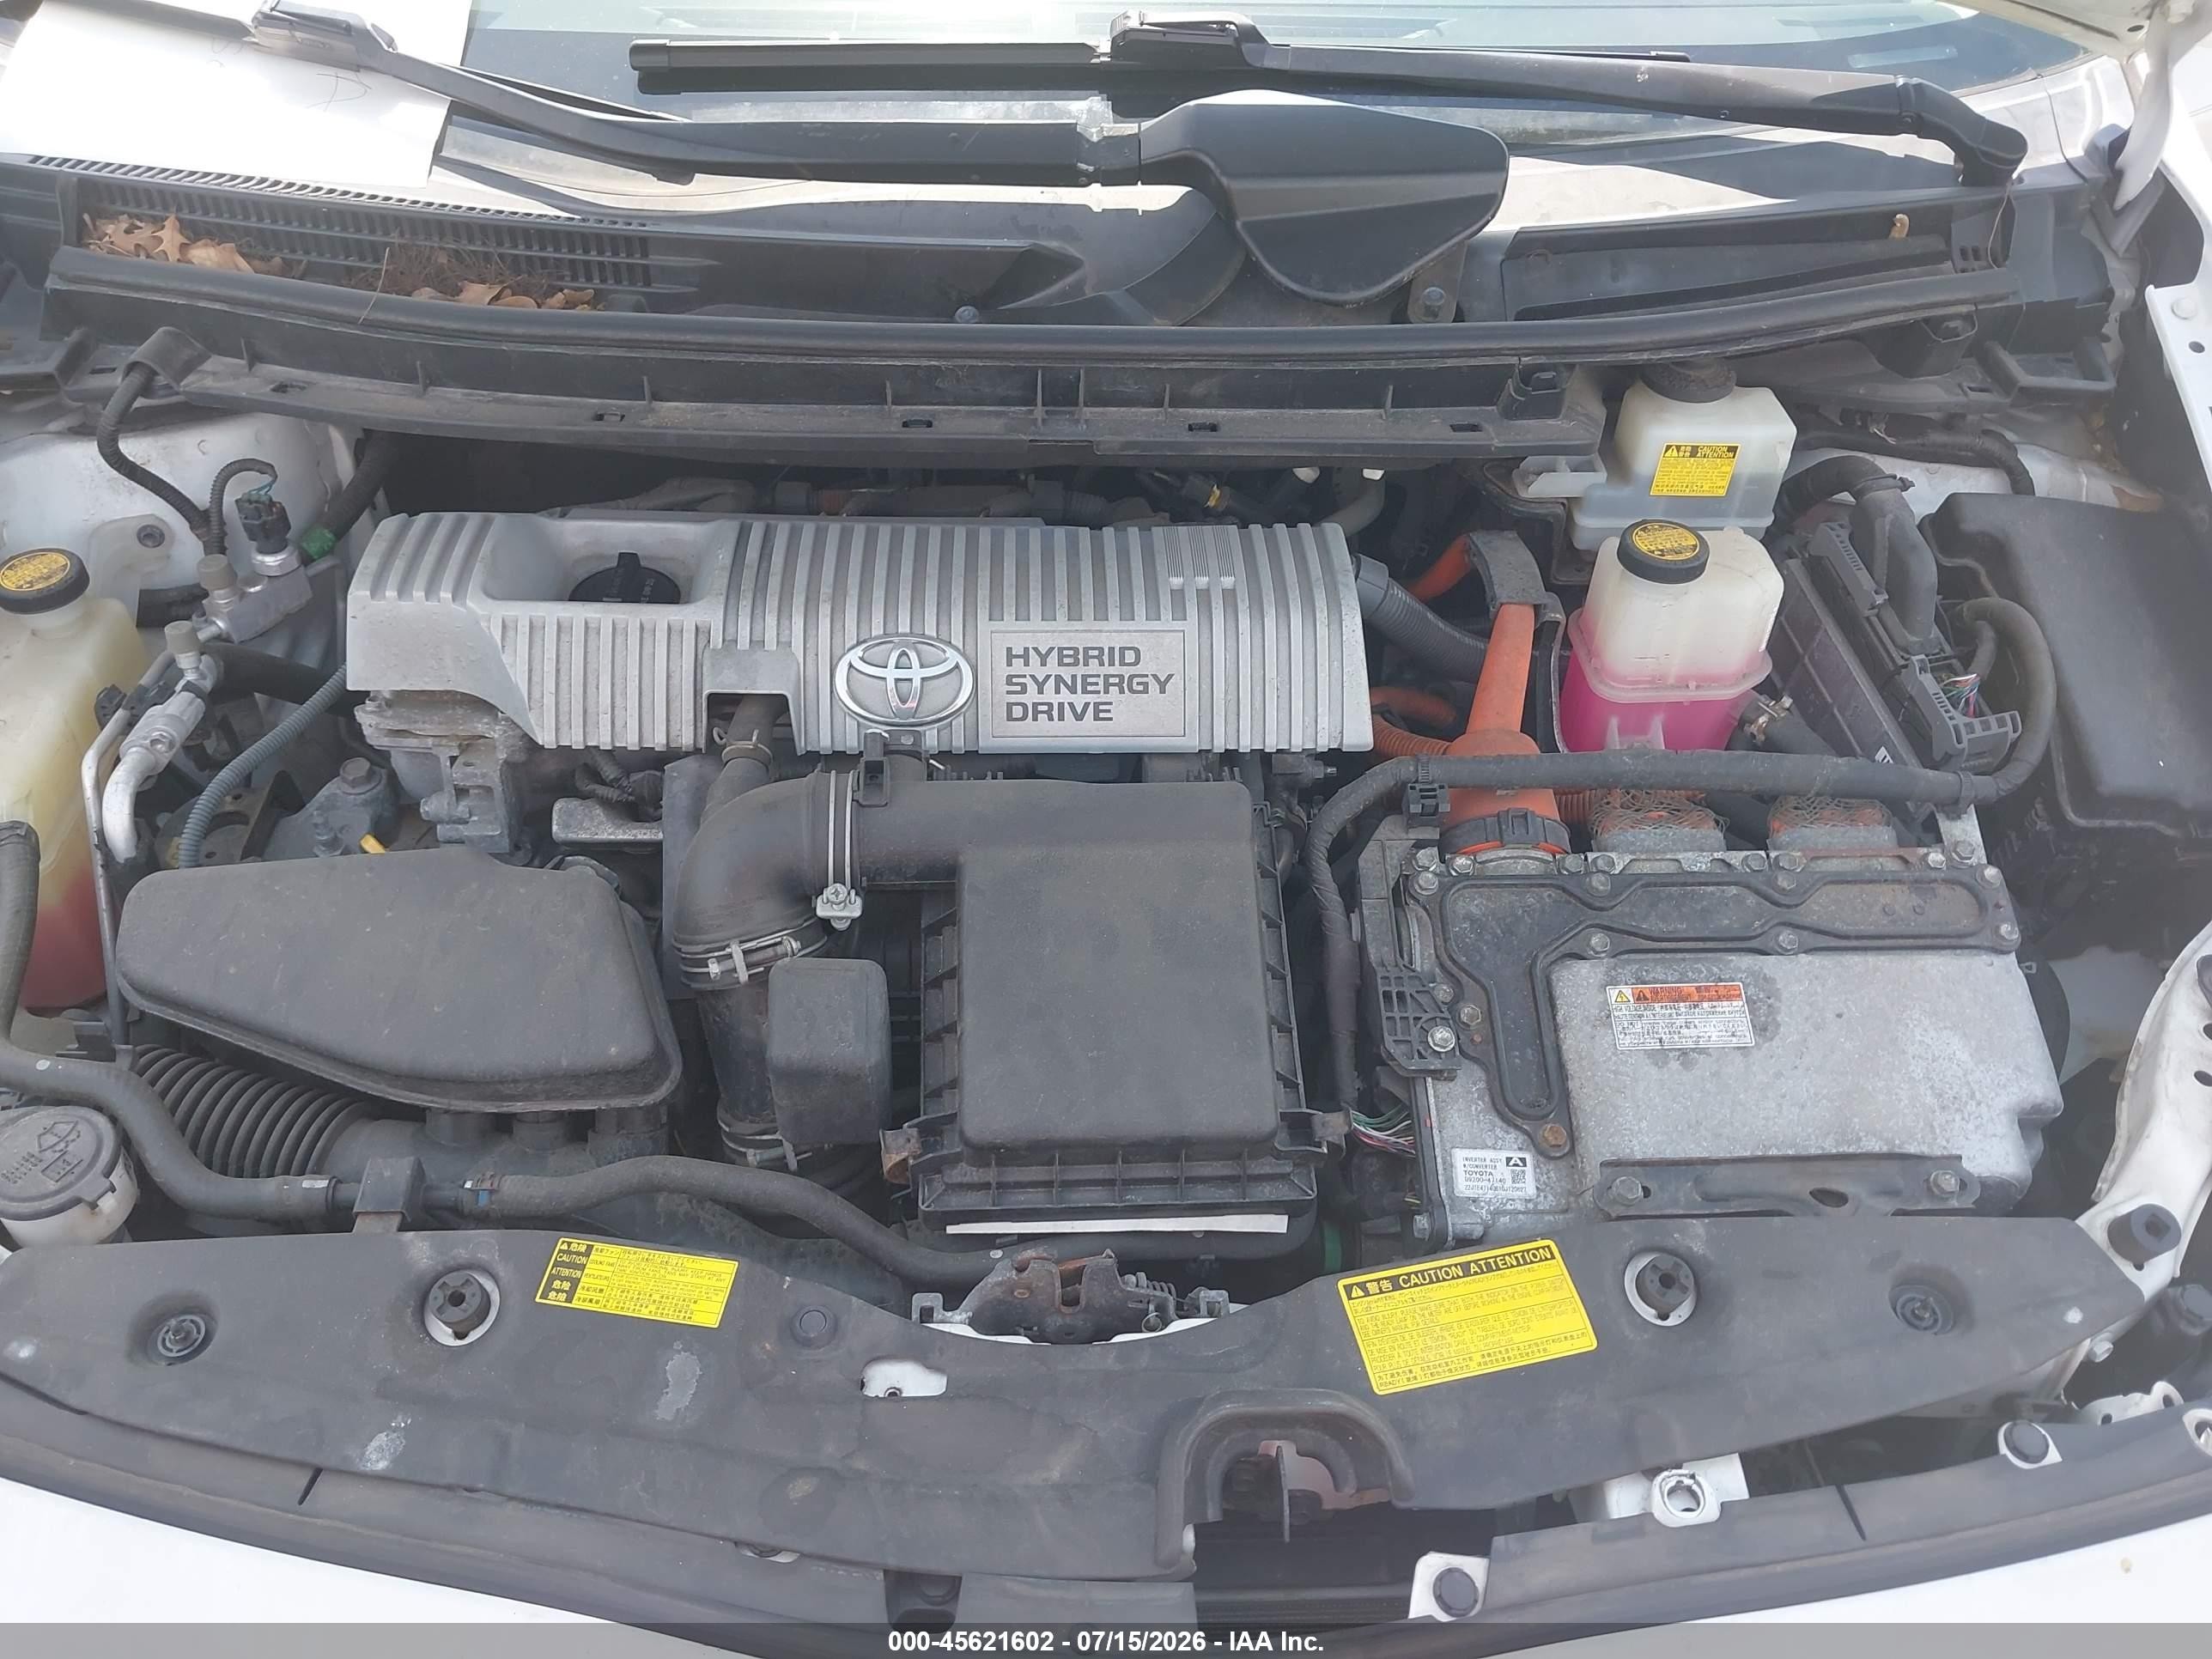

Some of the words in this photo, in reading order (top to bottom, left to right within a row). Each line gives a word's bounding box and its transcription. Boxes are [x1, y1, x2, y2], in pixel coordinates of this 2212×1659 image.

[1006, 647, 1140, 667] HYBRID
[1006, 673, 1175, 695] SYNERGY
[1006, 702, 1113, 721] DRIVE
[556, 1253, 588, 1265] CAUTION
[551, 1267, 583, 1279] ATTENTION
[1365, 1279, 1393, 1295] 警告
[1399, 1265, 1463, 1288] CAUTION
[1469, 1247, 1552, 1274] ATTENTION
